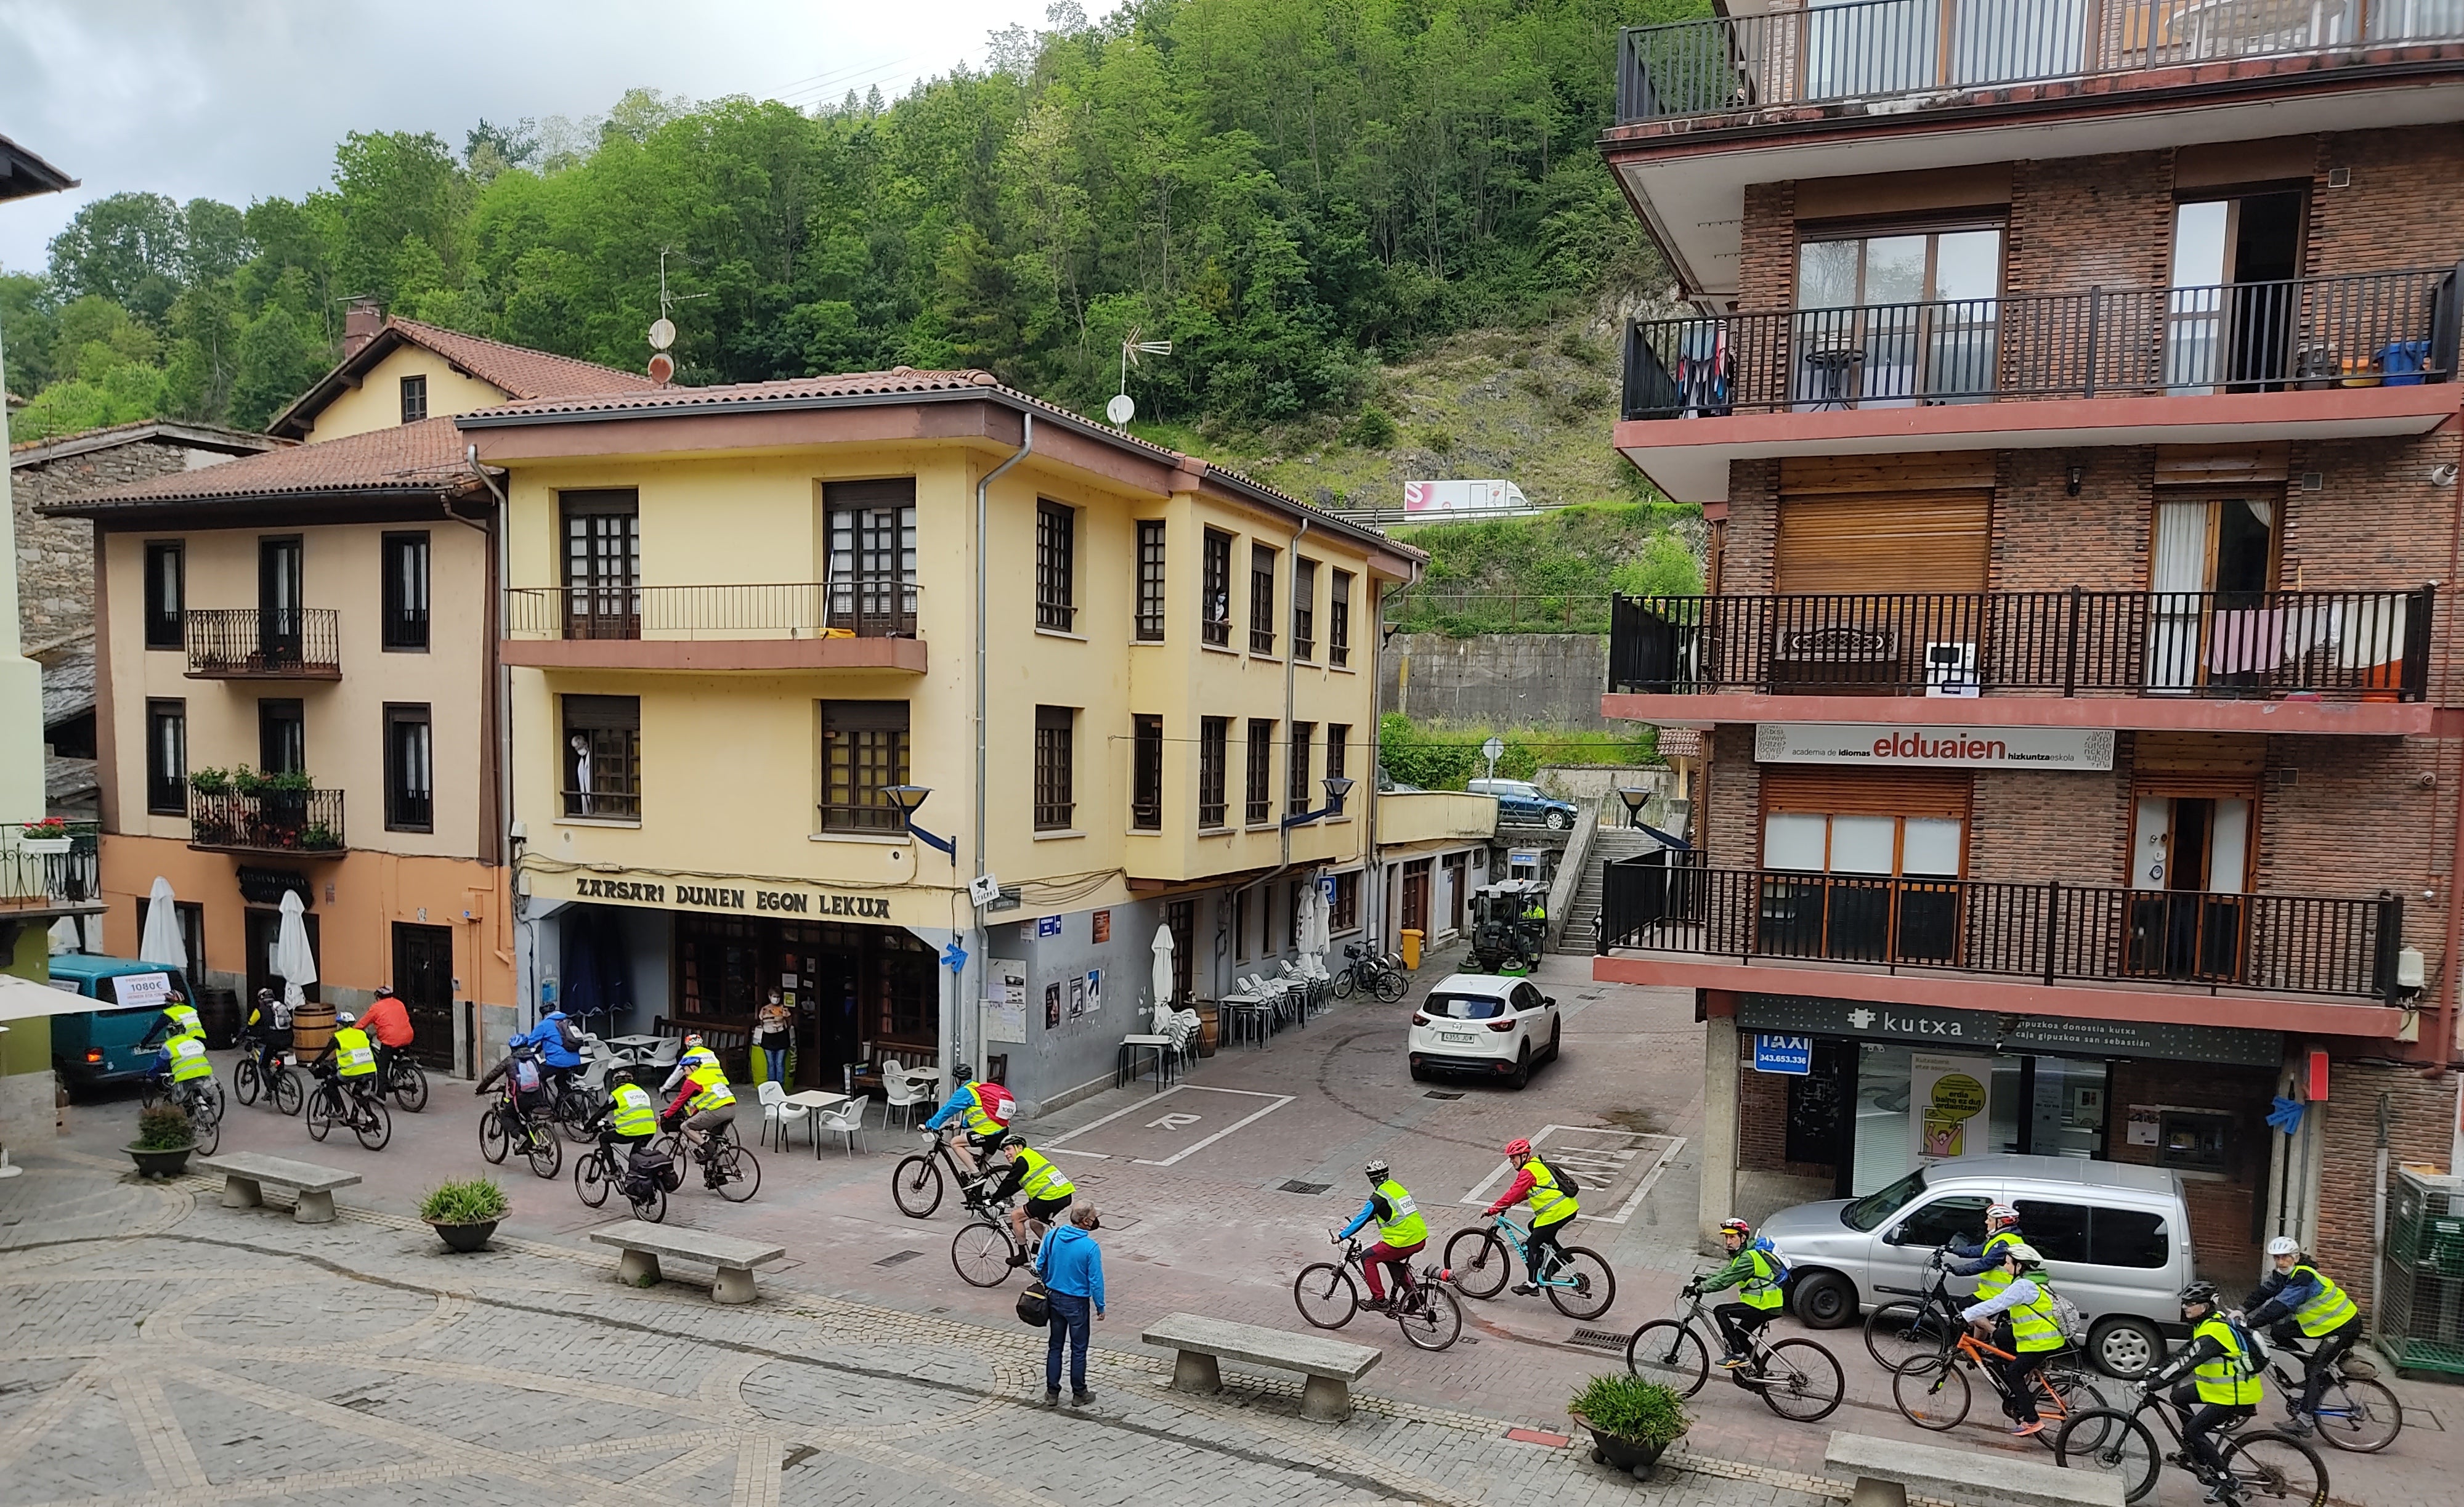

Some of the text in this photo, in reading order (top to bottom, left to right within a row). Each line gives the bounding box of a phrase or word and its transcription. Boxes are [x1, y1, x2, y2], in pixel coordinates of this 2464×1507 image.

[1792, 747, 1826, 757] academia
[1827, 748, 1836, 757] de
[1838, 748, 1871, 757] idiomas
[1873, 732, 2005, 760] elduaien
[1321, 880, 1332, 894] P
[676, 885, 745, 908] DUNEN
[756, 891, 808, 912] EGON
[819, 895, 890, 919] LEKUA
[131, 981, 163, 993] 1080€
[1883, 1012, 1963, 1036] kutxa
[2063, 1023, 2105, 1033] donostia
[2109, 1026, 2136, 1036] kutxa
[2016, 1031, 2034, 1040] caja
[2038, 1032, 2080, 1042] gipuzkoa
[2104, 1038, 2150, 1048] sebastián
[1935, 1095, 1956, 1103] baino
[1144, 1112, 1202, 1131] R
